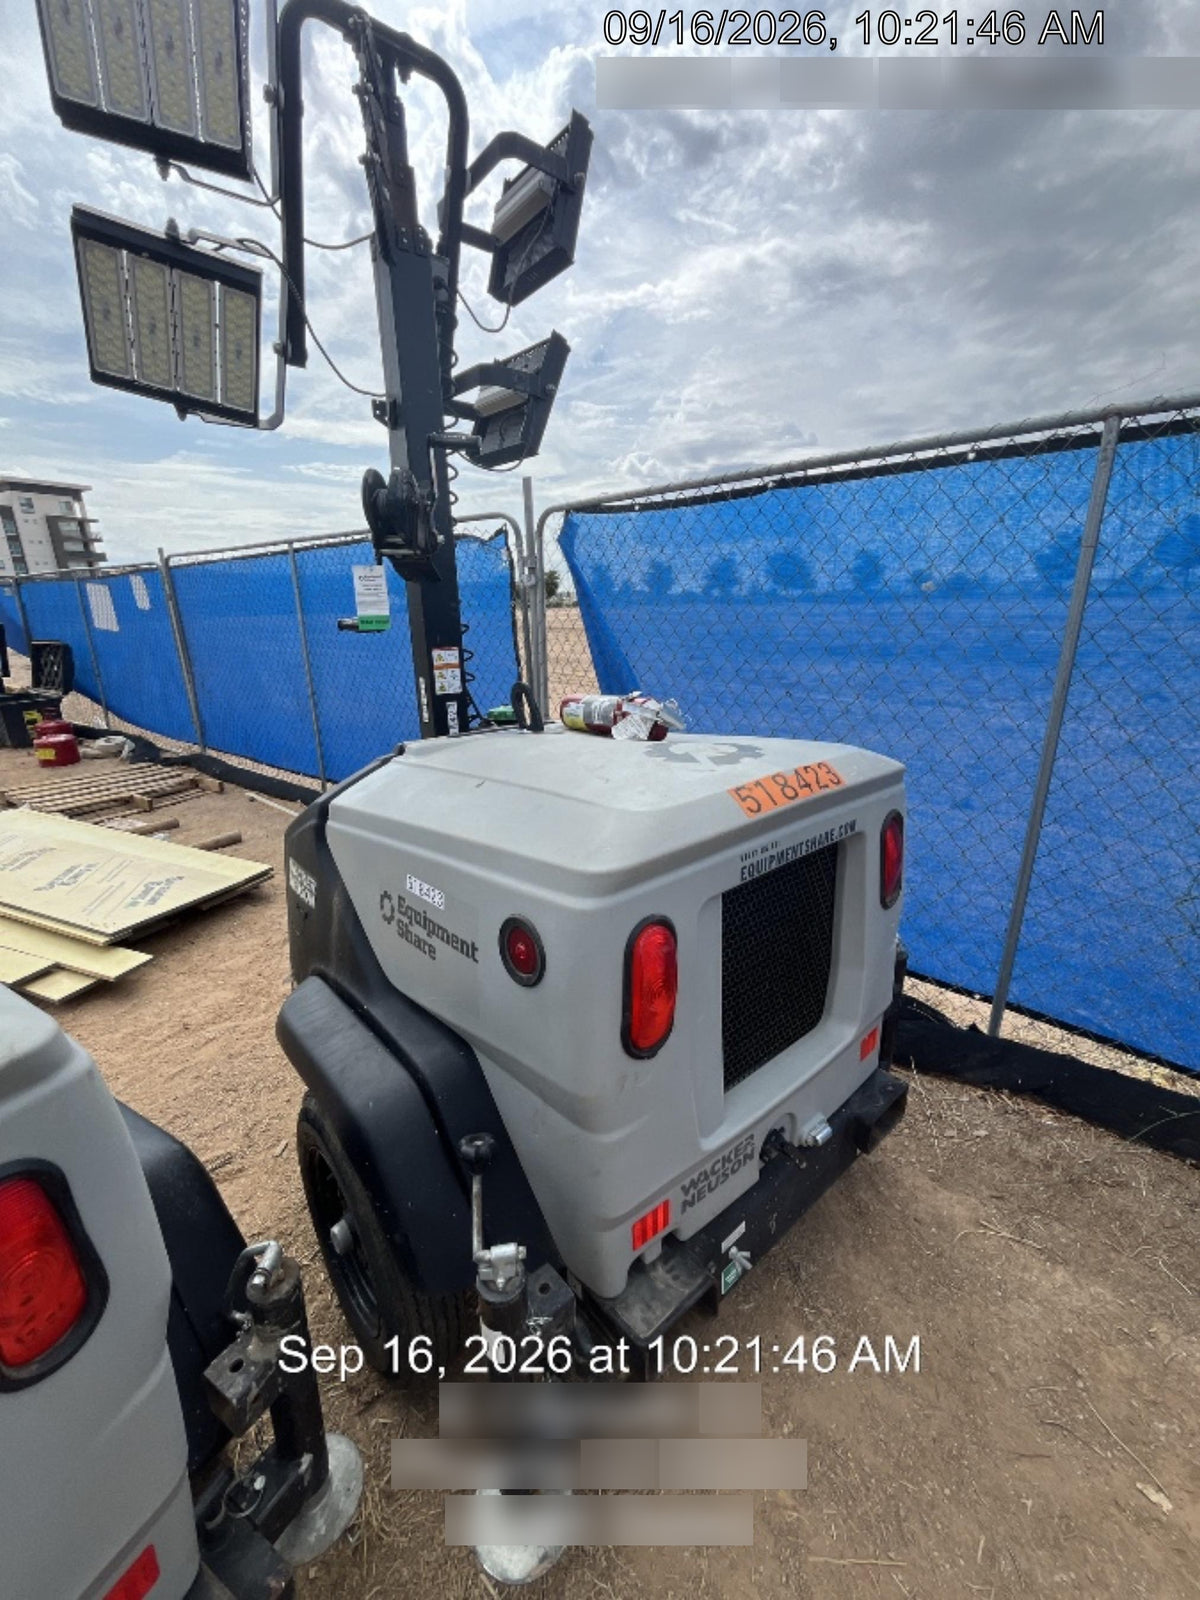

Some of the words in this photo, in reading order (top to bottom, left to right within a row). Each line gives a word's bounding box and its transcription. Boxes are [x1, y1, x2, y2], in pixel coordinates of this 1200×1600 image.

[740, 818, 858, 881] EQUIPMENTSHARE.COM
[397, 919, 436, 960] Share
[398, 894, 479, 964] Equipment
[681, 1133, 755, 1197] WACKER
[681, 1146, 755, 1215] NEUSON
